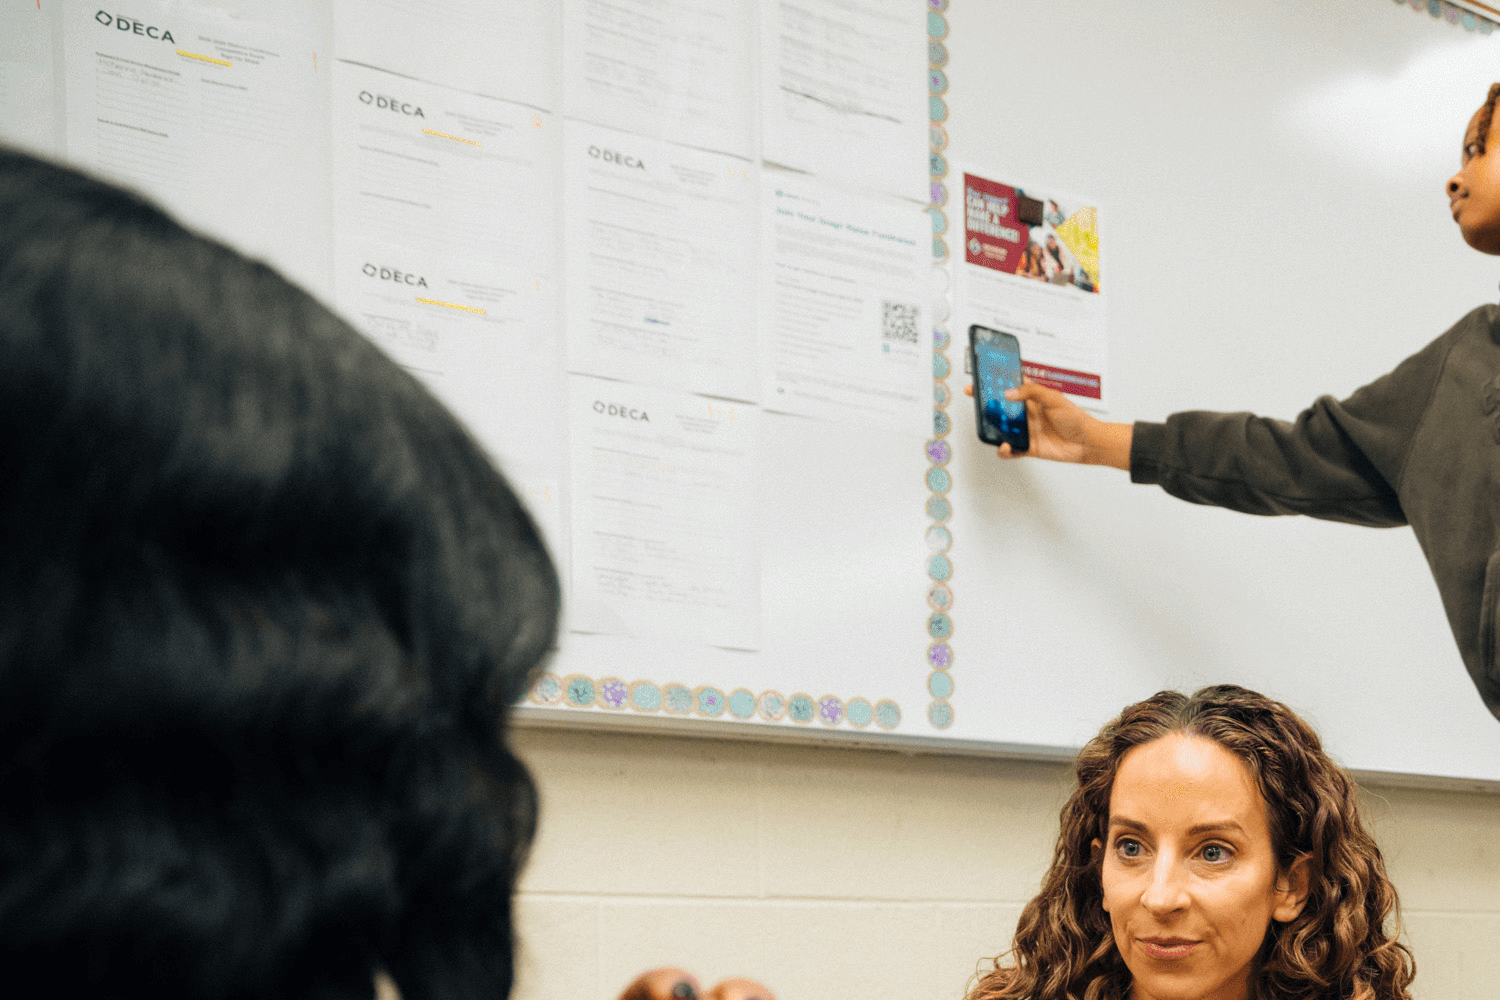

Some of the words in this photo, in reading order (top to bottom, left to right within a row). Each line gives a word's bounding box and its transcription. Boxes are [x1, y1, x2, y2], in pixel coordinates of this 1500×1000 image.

[116, 17, 176, 45] DECA
[376, 95, 425, 118] DECA
[602, 150, 646, 171] DECA
[986, 199, 1010, 218] HELP
[380, 266, 429, 289] DECA
[607, 404, 650, 423] DECA
